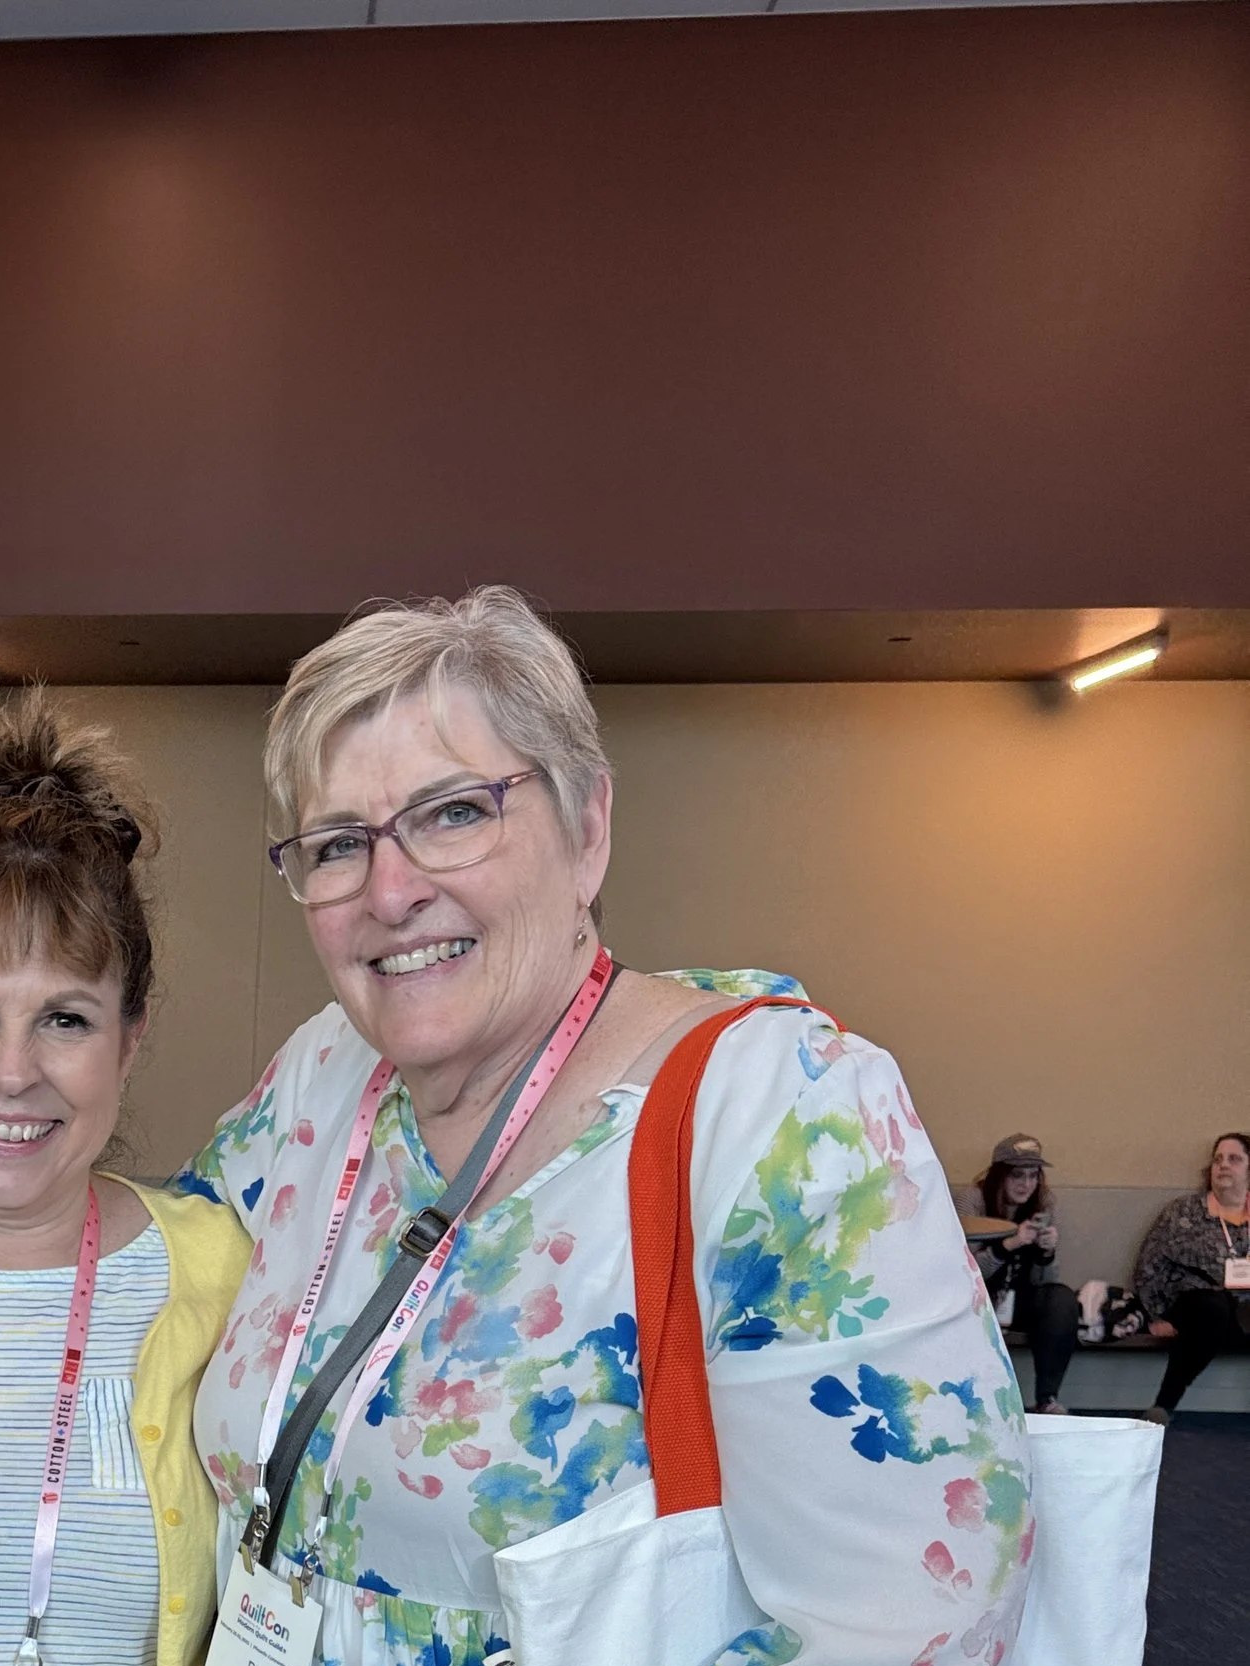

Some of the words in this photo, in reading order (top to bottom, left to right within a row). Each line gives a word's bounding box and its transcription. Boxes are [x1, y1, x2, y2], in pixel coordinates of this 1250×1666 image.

[302, 1264, 327, 1315] COTTON
[325, 1211, 344, 1251] STEEL
[391, 1279, 429, 1333] QuiltCon
[56, 1393, 73, 1428] STEEL
[47, 1437, 66, 1483] COTTON
[241, 1594, 290, 1642] QuiltCon
